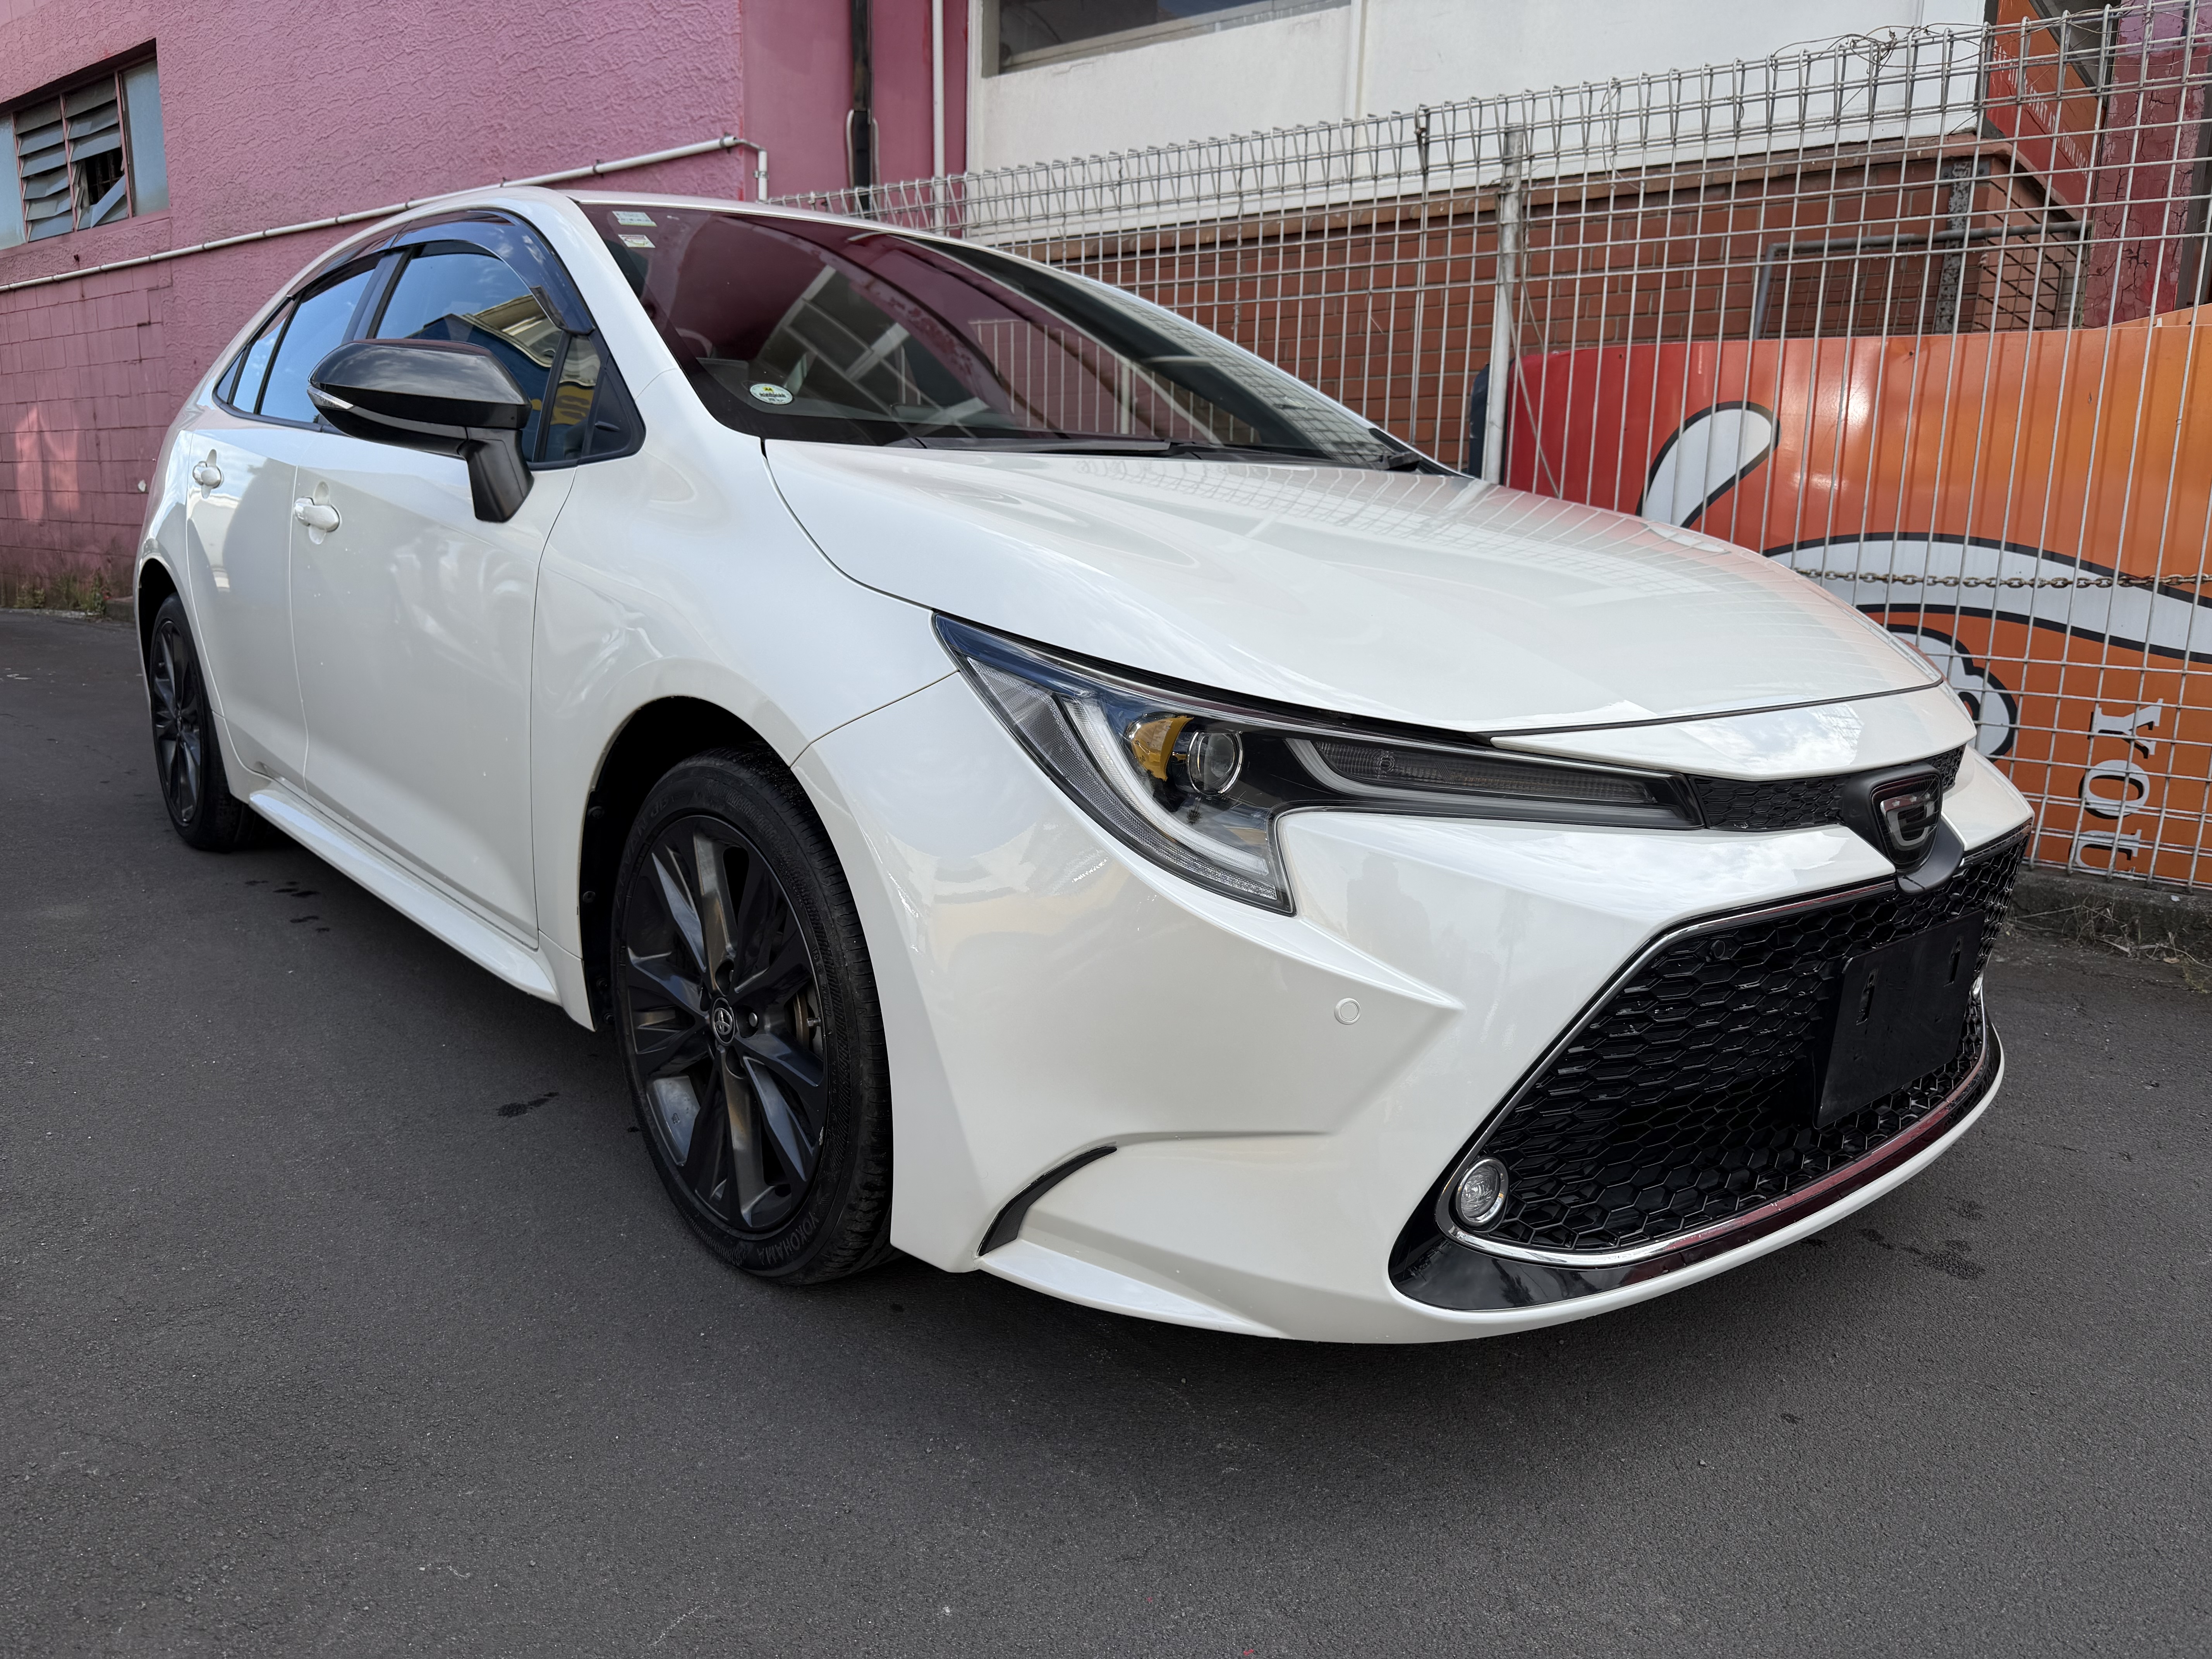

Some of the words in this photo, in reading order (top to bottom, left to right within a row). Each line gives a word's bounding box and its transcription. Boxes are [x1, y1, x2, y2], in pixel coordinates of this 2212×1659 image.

[2029, 86, 2048, 124] START
[2062, 129, 2076, 162] YOUR
[757, 1211, 820, 1266] YOKOHAMA
